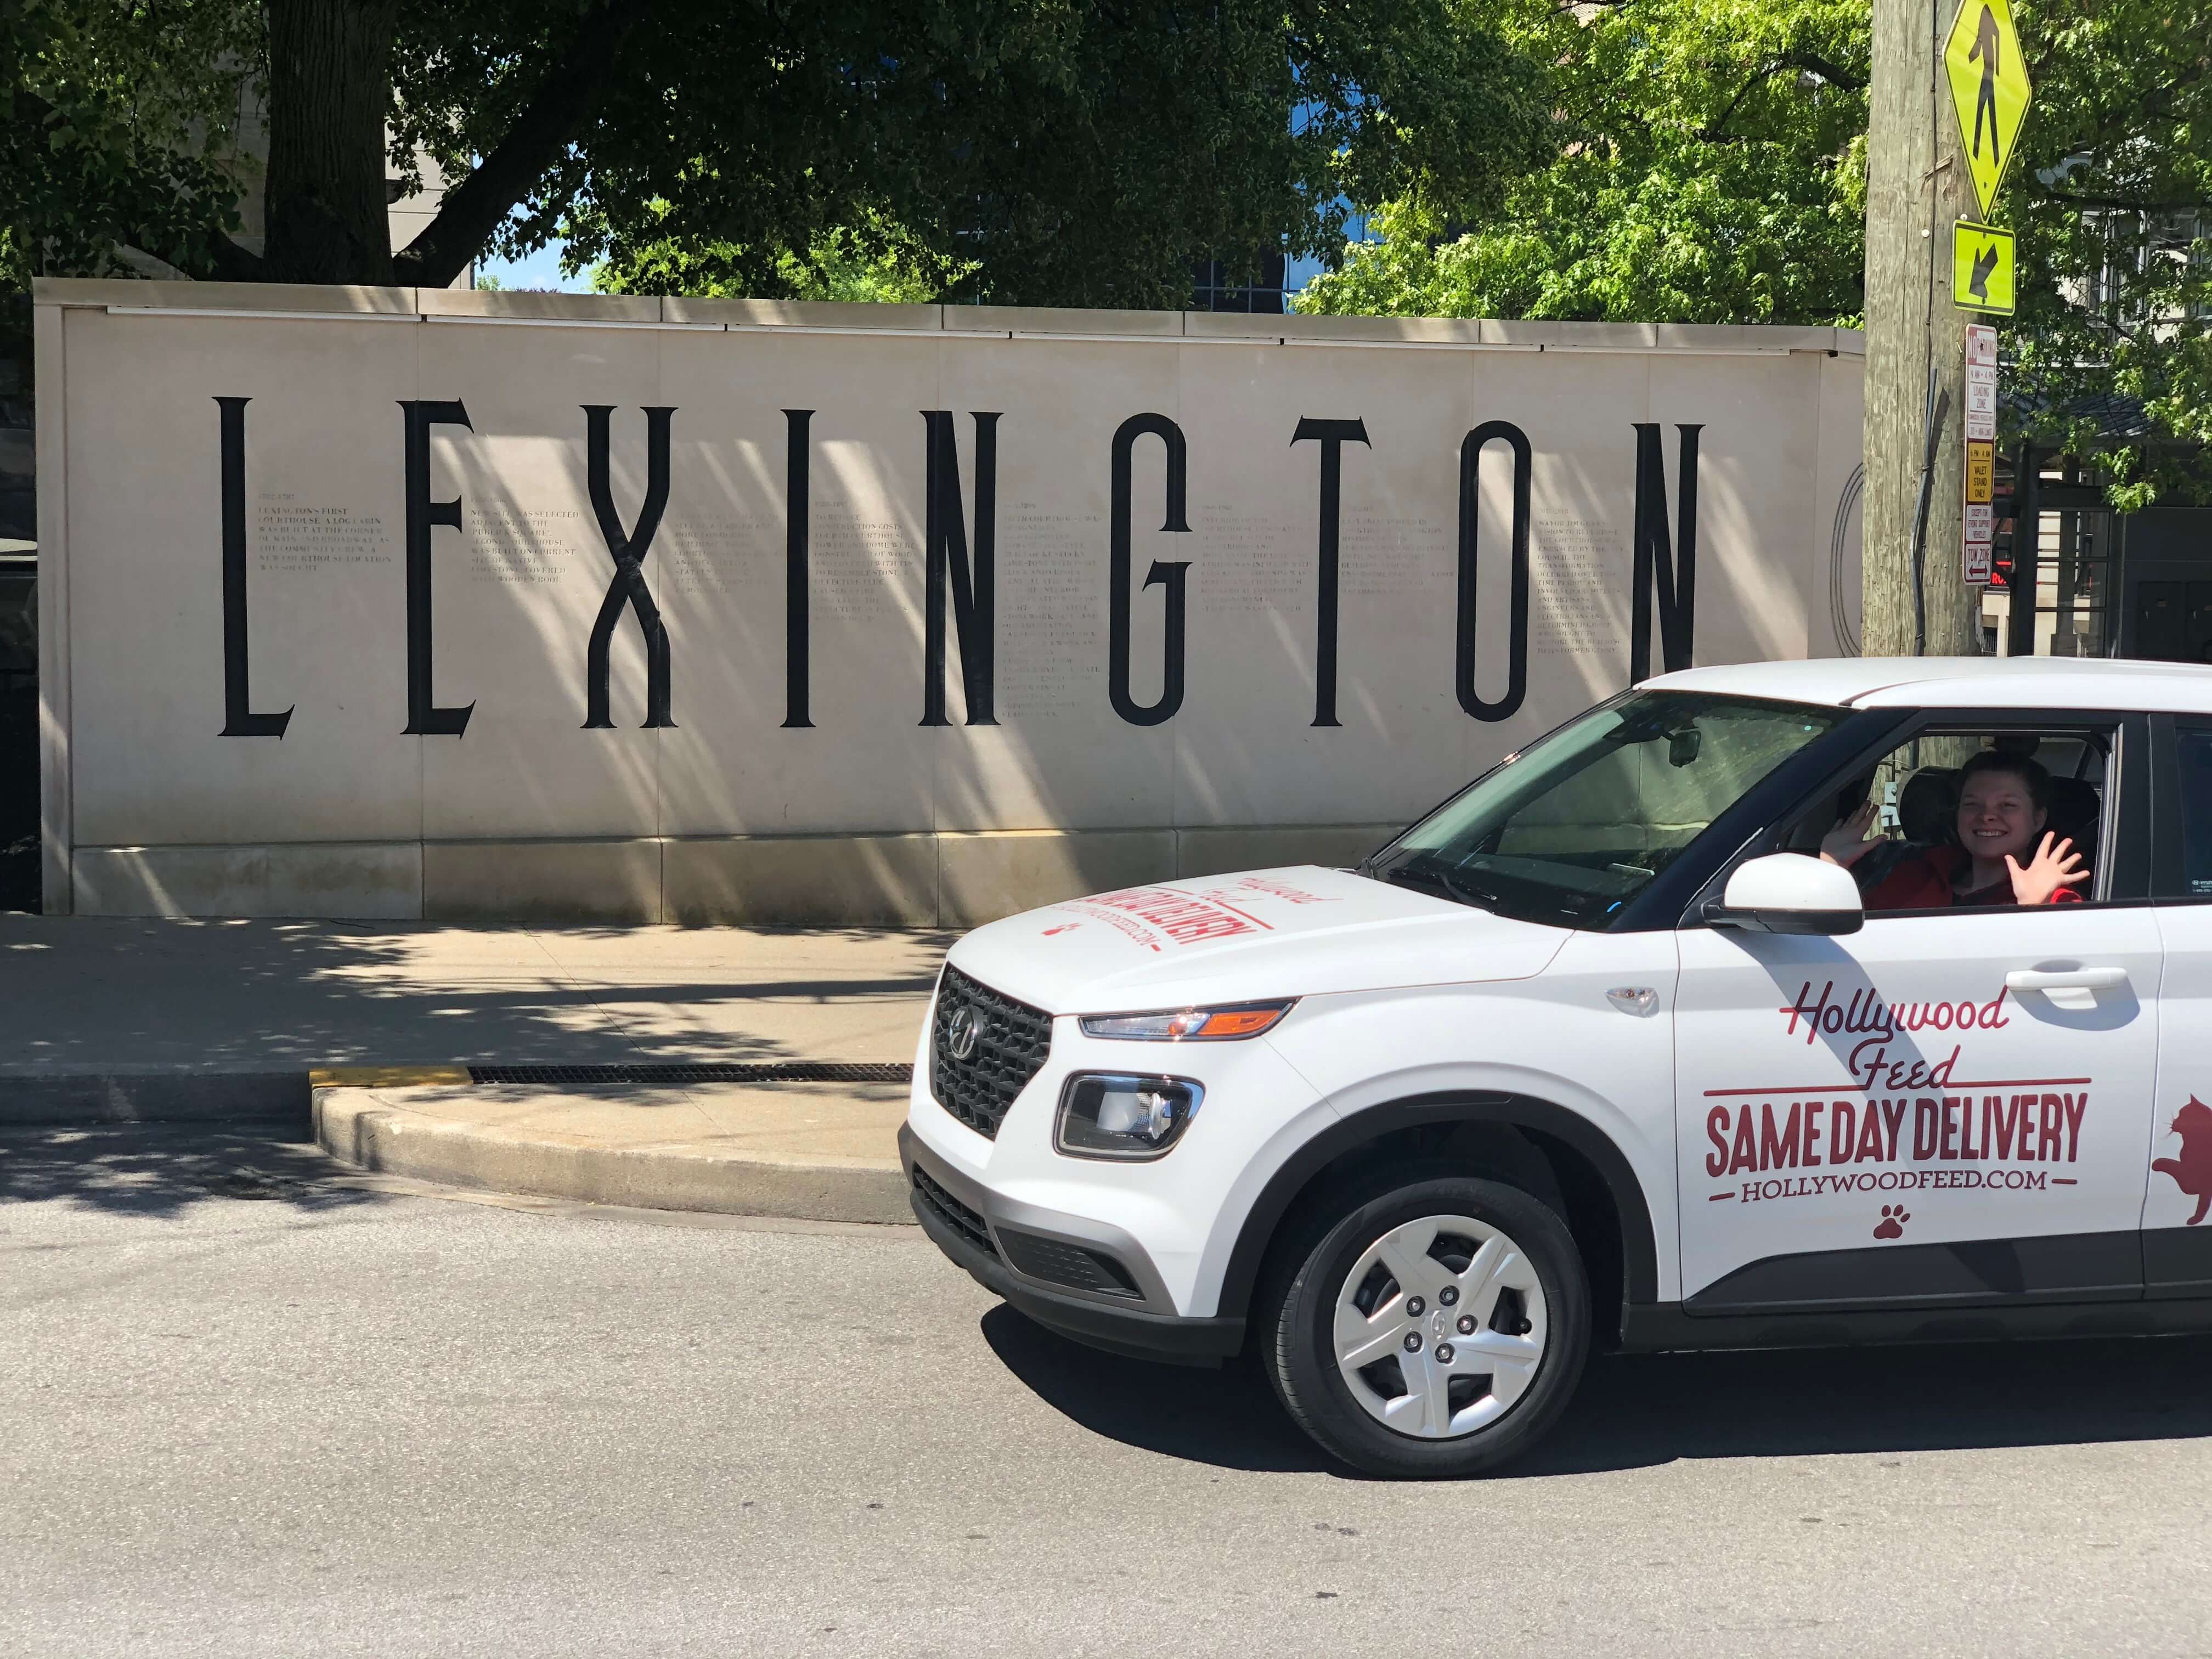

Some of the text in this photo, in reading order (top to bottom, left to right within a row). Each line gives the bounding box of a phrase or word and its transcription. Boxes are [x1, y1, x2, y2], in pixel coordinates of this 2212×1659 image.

[1968, 335, 1976, 358] NO
[1971, 370, 1973, 379] 9
[1975, 370, 1980, 379] AM
[1989, 371, 1994, 380] PM
[1973, 386, 1989, 397] LOADING
[1976, 398, 1986, 409] ZONE
[1974, 465, 1987, 475] VALET
[1973, 477, 1987, 486] STAND
[1974, 489, 1985, 498] ONLY
[1971, 509, 1982, 517] EXCEPT
[1968, 520, 1978, 528] EVENT
[1968, 549, 1990, 563] TOW ZONE
[212, 397, 1707, 740] LEXINGTON
[1136, 902, 1258, 944] DELIVERY
[1779, 980, 2009, 1045] Hollywood
[1849, 1040, 1961, 1091] Feed
[1706, 1092, 2088, 1177] SAME DAY DELIVERY
[1741, 1170, 2047, 1203] HOLLYWOODFEED.COM
